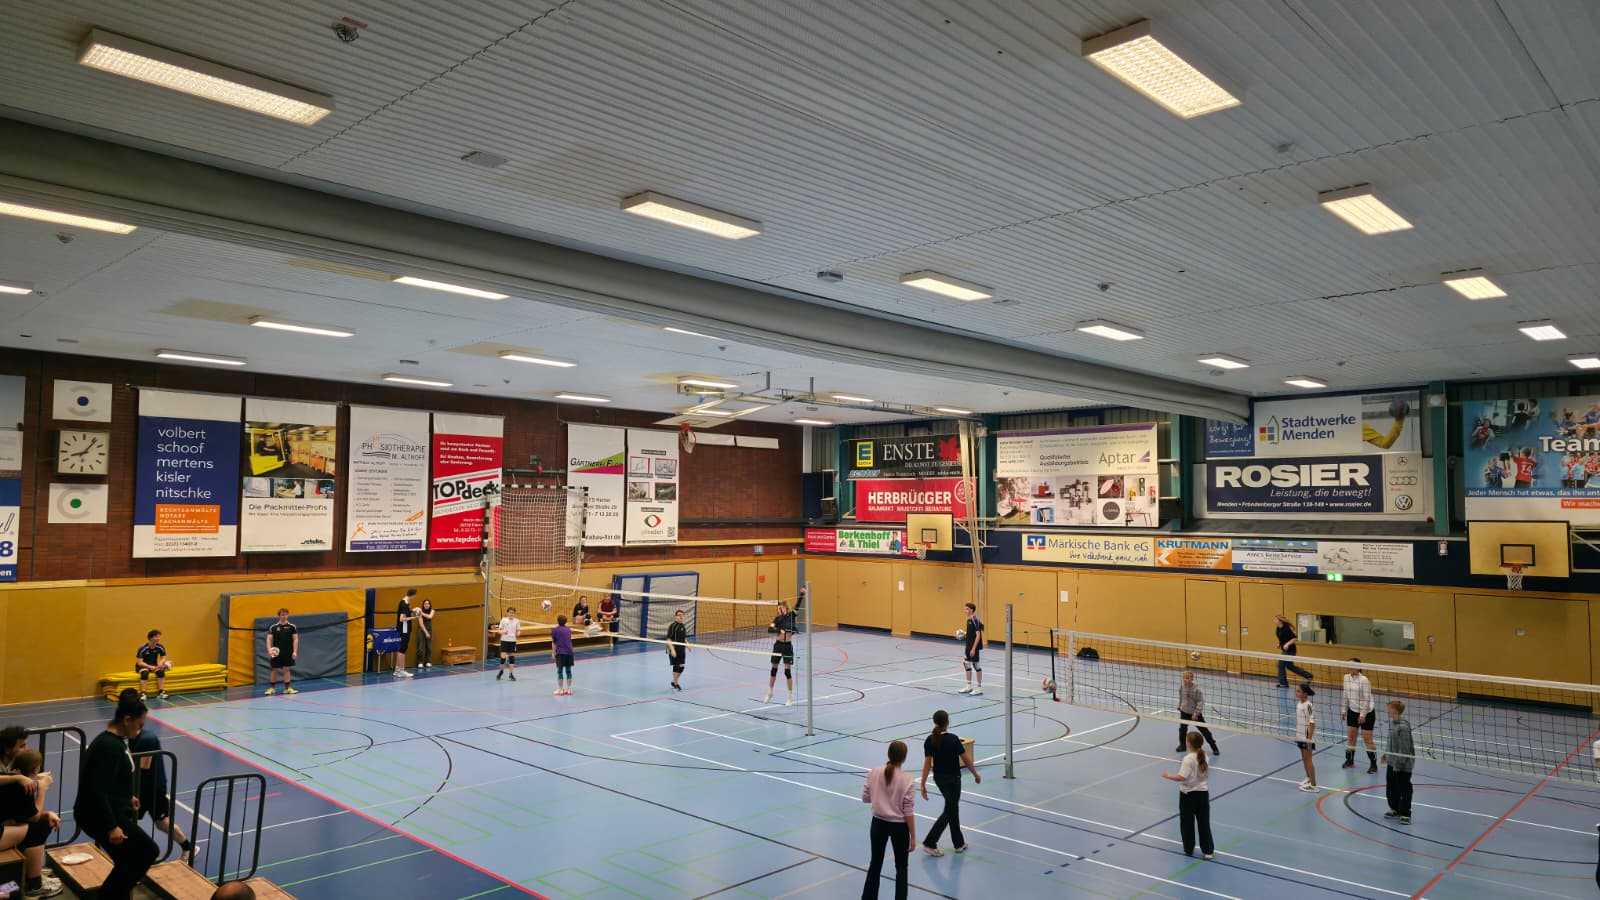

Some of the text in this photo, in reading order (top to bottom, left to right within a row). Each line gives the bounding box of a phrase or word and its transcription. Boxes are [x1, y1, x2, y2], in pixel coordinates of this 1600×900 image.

[1281, 413, 1356, 428] Stadtwerke
[158, 426, 206, 439] volbert
[1282, 428, 1335, 441] Menden
[156, 441, 205, 454] schoof
[883, 442, 935, 461] ENSTE
[156, 458, 214, 469] mertens
[1099, 451, 1136, 467] Aptar
[156, 470, 191, 483] kisler
[1216, 462, 1370, 488] ROSIER
[155, 486, 212, 499] nitschke
[868, 488, 952, 505] HERBRÜGGER
[1270, 487, 1372, 499] Leistung, die bewegt!
[263, 503, 328, 511] Packmittel-Profis
[857, 540, 880, 549] Thiel
[1048, 538, 1149, 551] Märkische Bank eG
[1157, 540, 1229, 549] KRUTMANN
